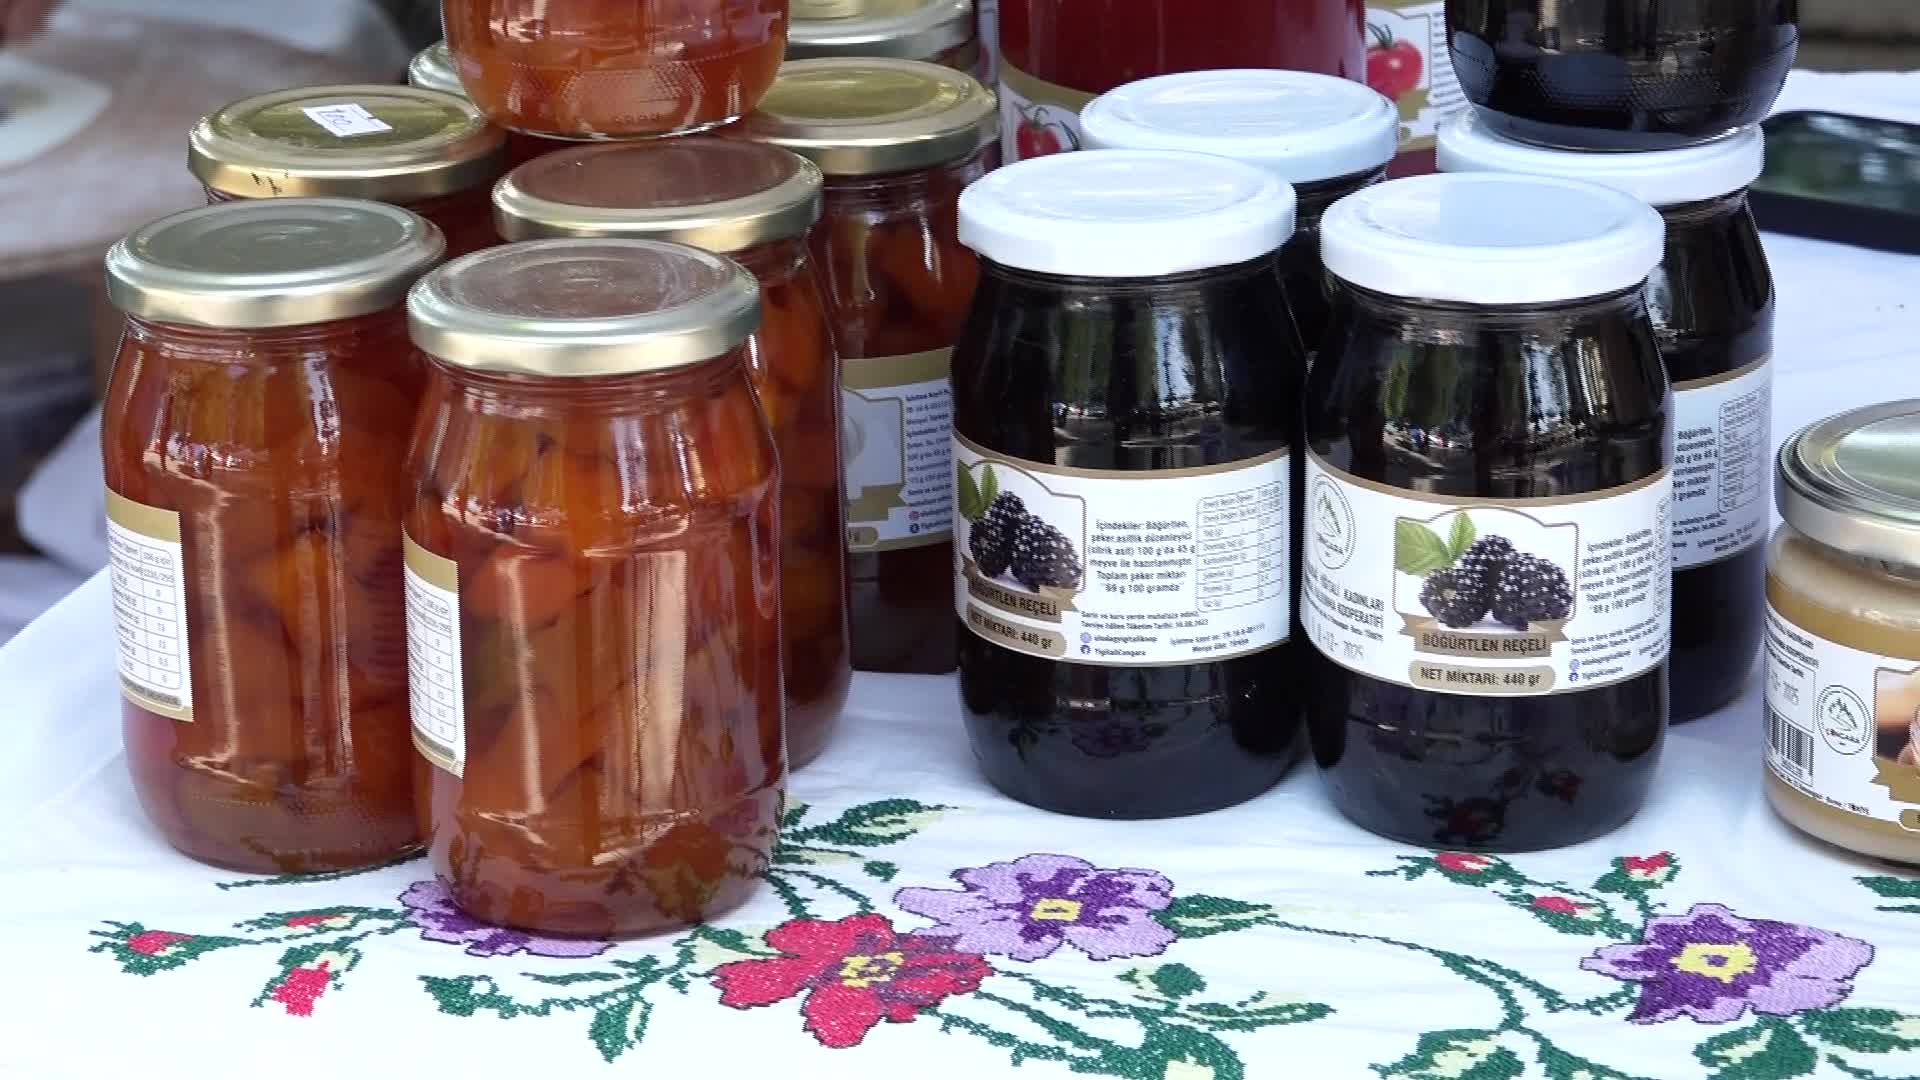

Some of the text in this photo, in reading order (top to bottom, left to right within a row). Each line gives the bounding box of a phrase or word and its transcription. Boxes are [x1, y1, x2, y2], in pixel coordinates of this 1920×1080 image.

[1096, 519, 1189, 531] İçindekiler: Böğürtlen,
[1145, 531, 1192, 543] düzenleyici
[1115, 546, 1135, 557] asit)
[1138, 547, 1154, 555] 100
[1178, 544, 1188, 553] 45
[1190, 545, 1196, 554] g
[1090, 559, 1118, 569] meyve
[1120, 559, 1131, 568] ile
[1097, 570, 1187, 582] Toplam şeker miktarı
[1120, 585, 1126, 594] g
[1129, 584, 1145, 592] 100
[1344, 587, 1385, 612] KADINLARI
[1586, 591, 1612, 602] Toplam
[1019, 596, 1057, 616] REÇELİ
[1337, 603, 1384, 630] KOOPERATİFİ
[1021, 631, 1038, 646] 440
[1041, 638, 1053, 649] gr
[1422, 633, 1547, 655] BÖĞÜRTLEN REÇELİ
[1420, 666, 1542, 687] NET MİKTARI: 440 gr
